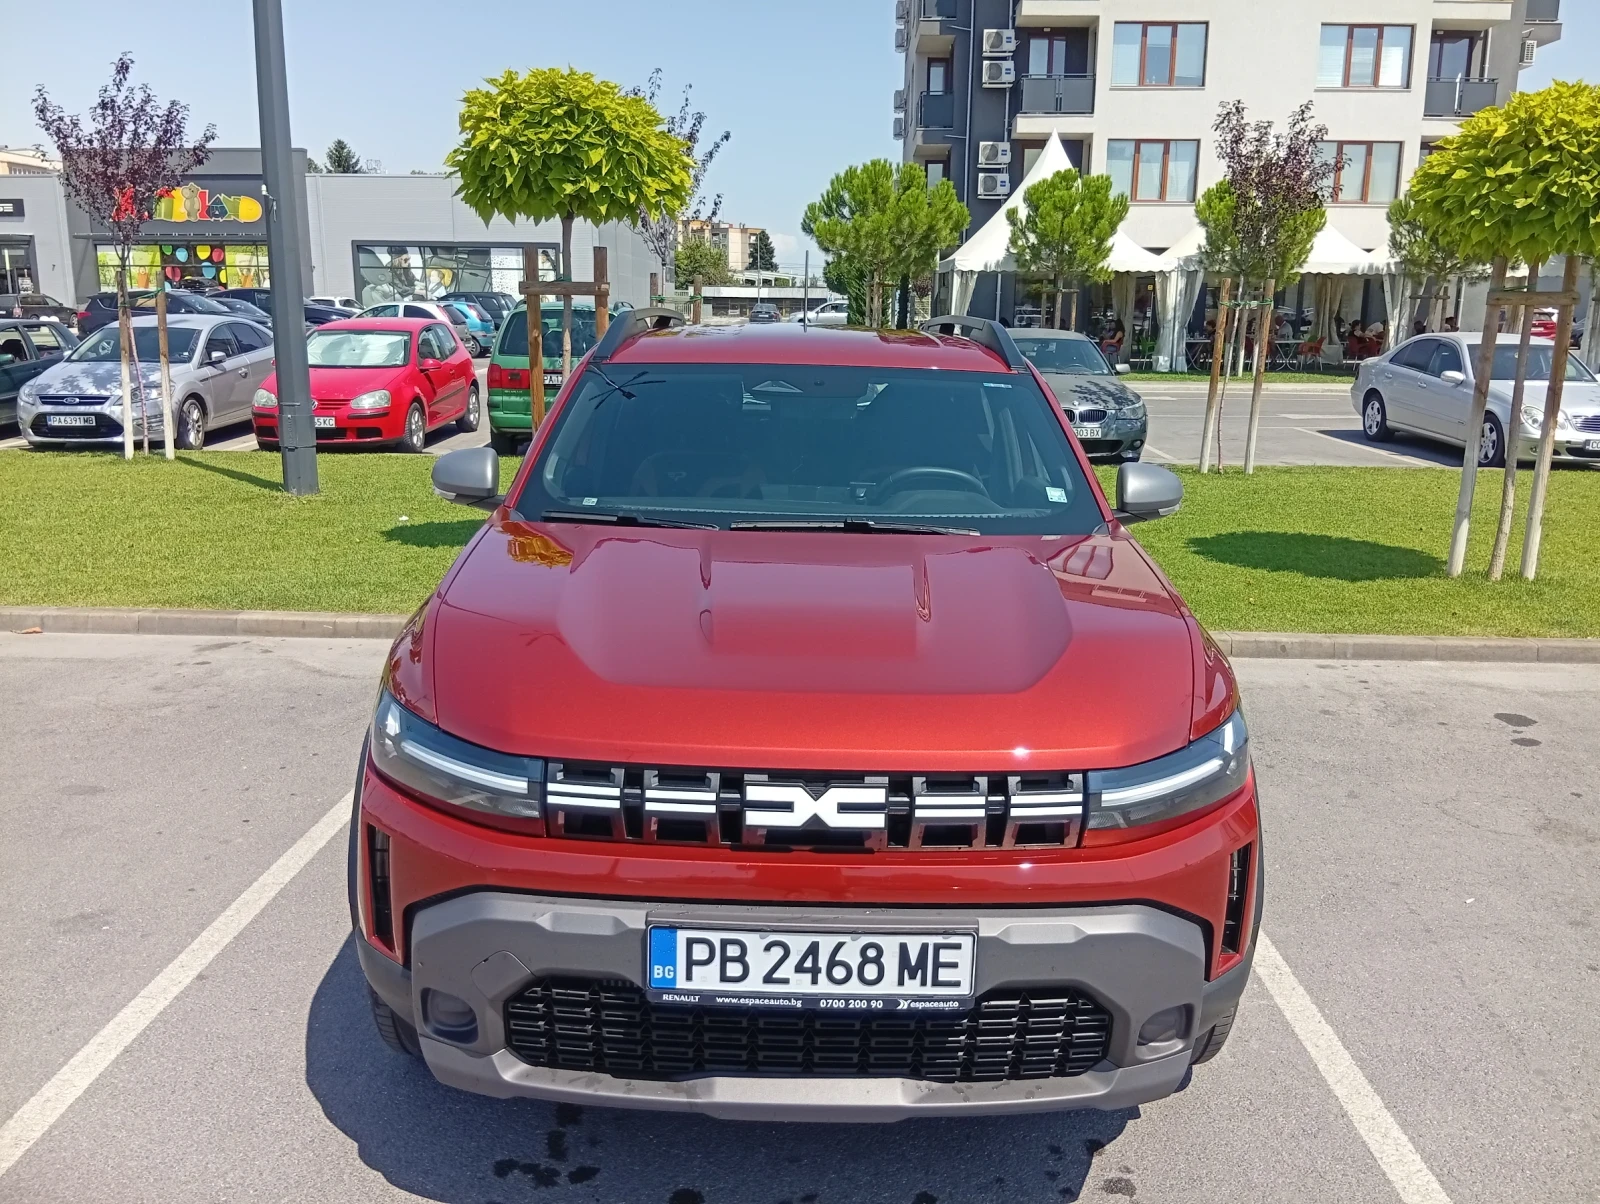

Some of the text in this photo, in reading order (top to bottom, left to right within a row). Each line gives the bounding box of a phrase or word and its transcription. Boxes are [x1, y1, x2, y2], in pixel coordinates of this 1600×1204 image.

[52, 416, 63, 425] PA
[63, 416, 82, 425] 6391
[685, 937, 962, 987] PB 2468 ME
[653, 965, 675, 979] BG
[662, 993, 959, 1010] RENAULT www.espaceauto.bg 0700 200 90 espaceauto
